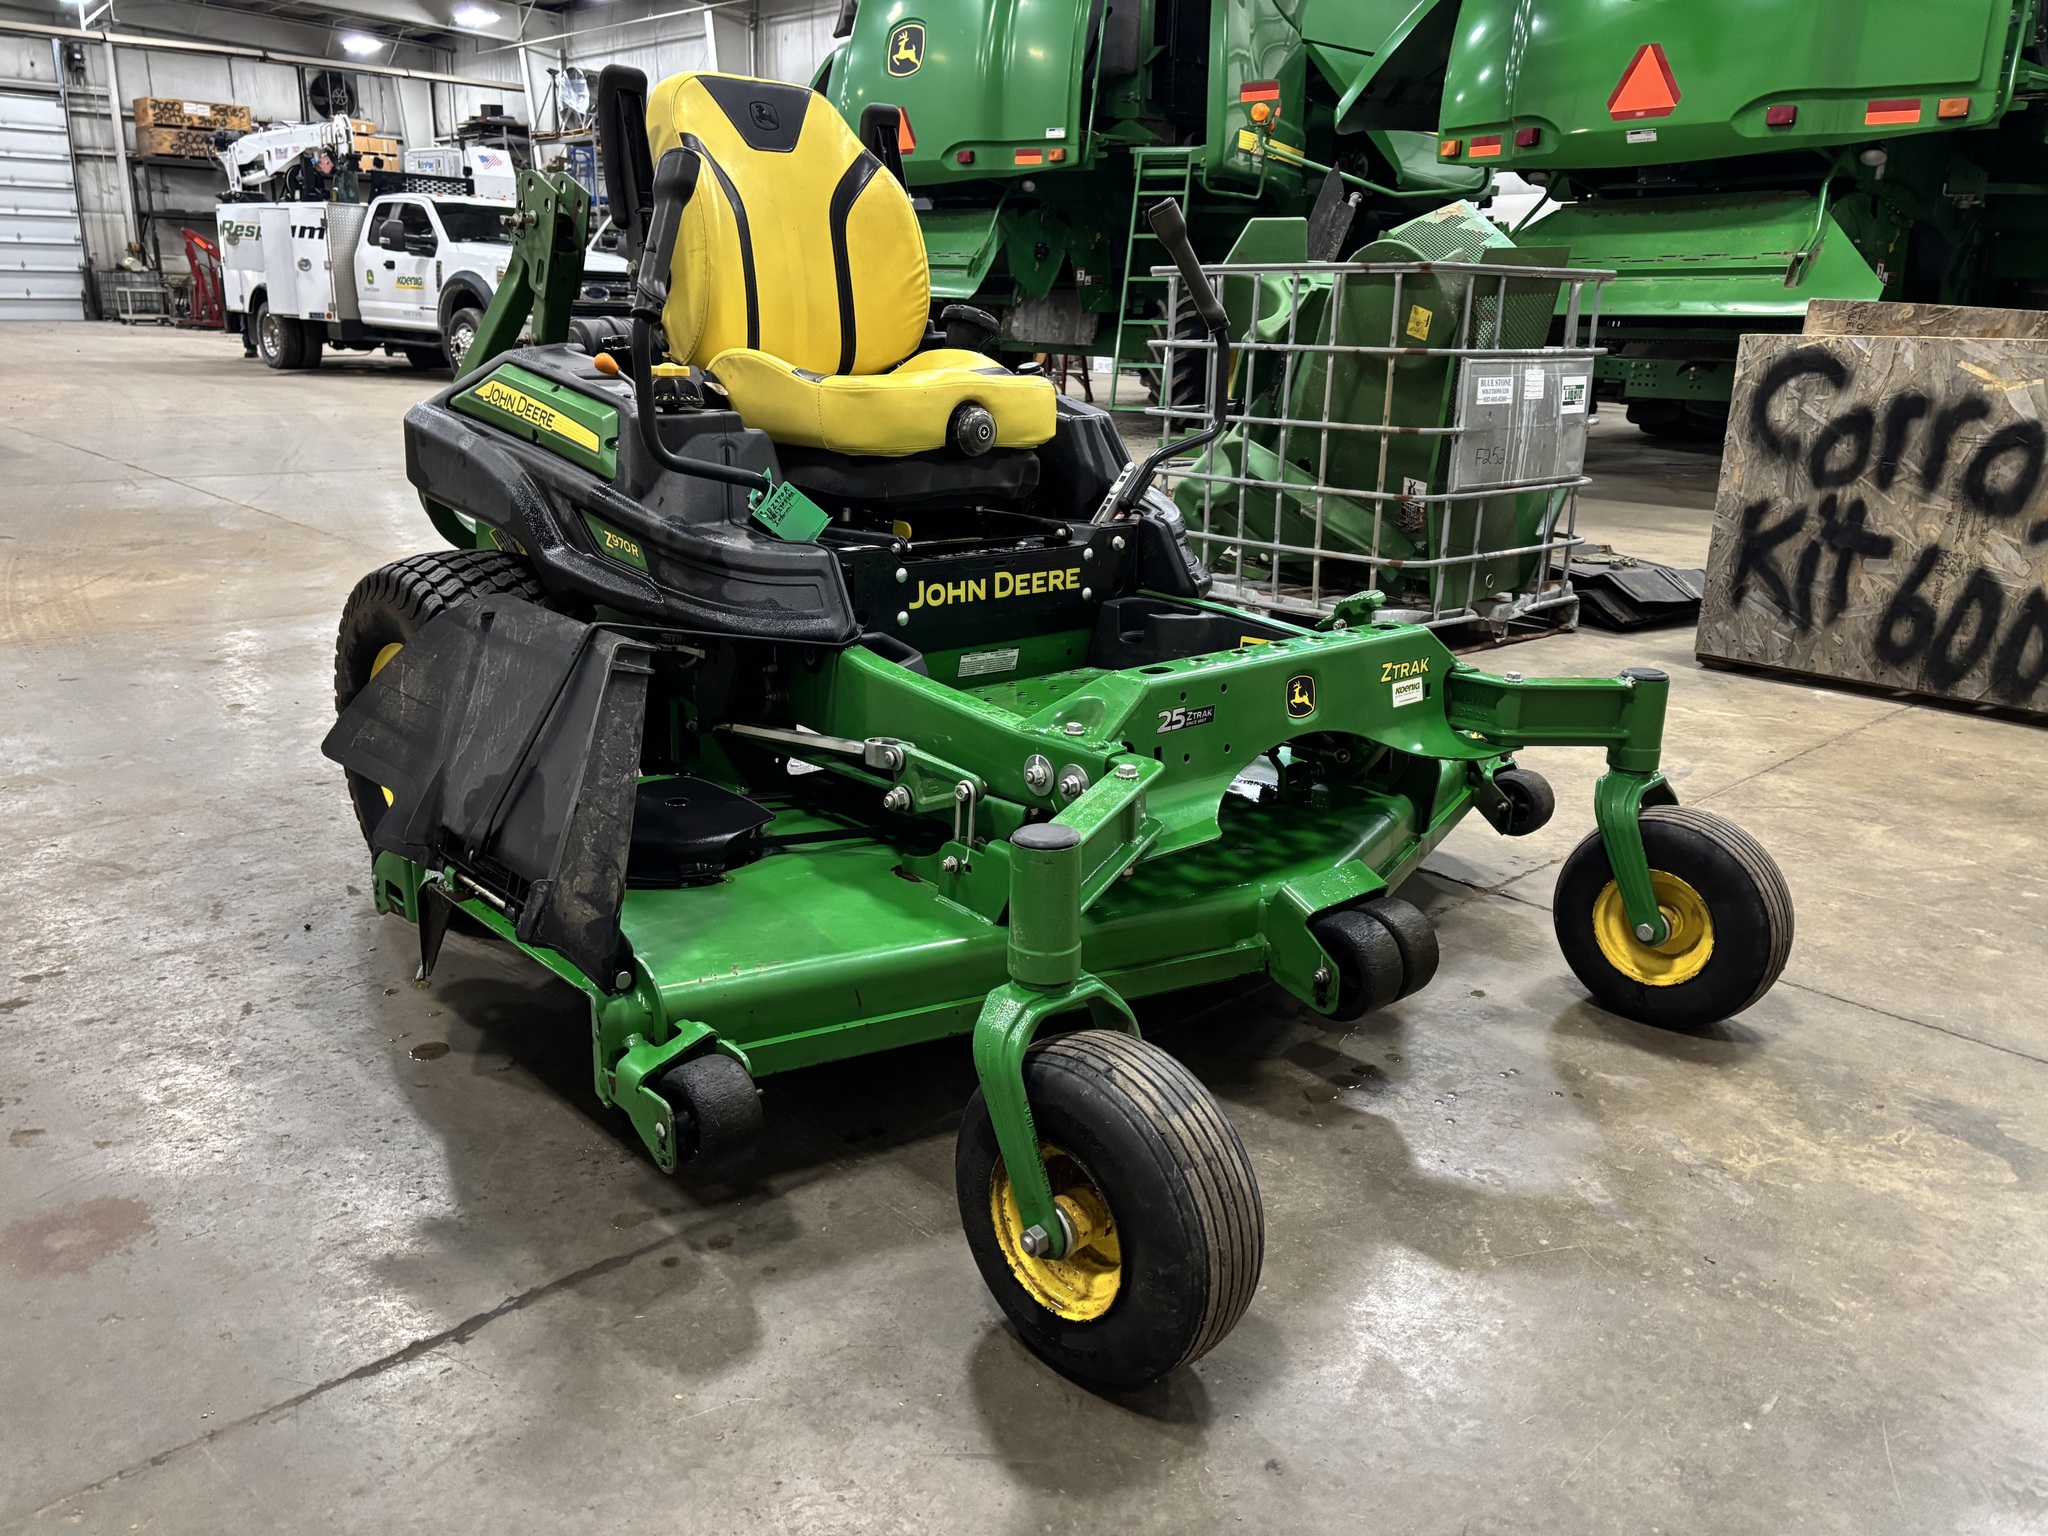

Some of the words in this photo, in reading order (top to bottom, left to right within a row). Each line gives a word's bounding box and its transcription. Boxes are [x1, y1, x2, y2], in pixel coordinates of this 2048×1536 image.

[485, 383, 516, 411] JOHN
[516, 395, 556, 429] DEERE
[1749, 345, 2048, 528] Corro
[603, 530, 640, 558] Z970R
[1732, 493, 1895, 629] Kit
[909, 578, 987, 610] JOHN
[994, 567, 1081, 599] DEERE
[1380, 657, 1430, 683] ZTRAK
[1157, 706, 1186, 734] 25
[1186, 708, 1213, 721] ZTRAK
